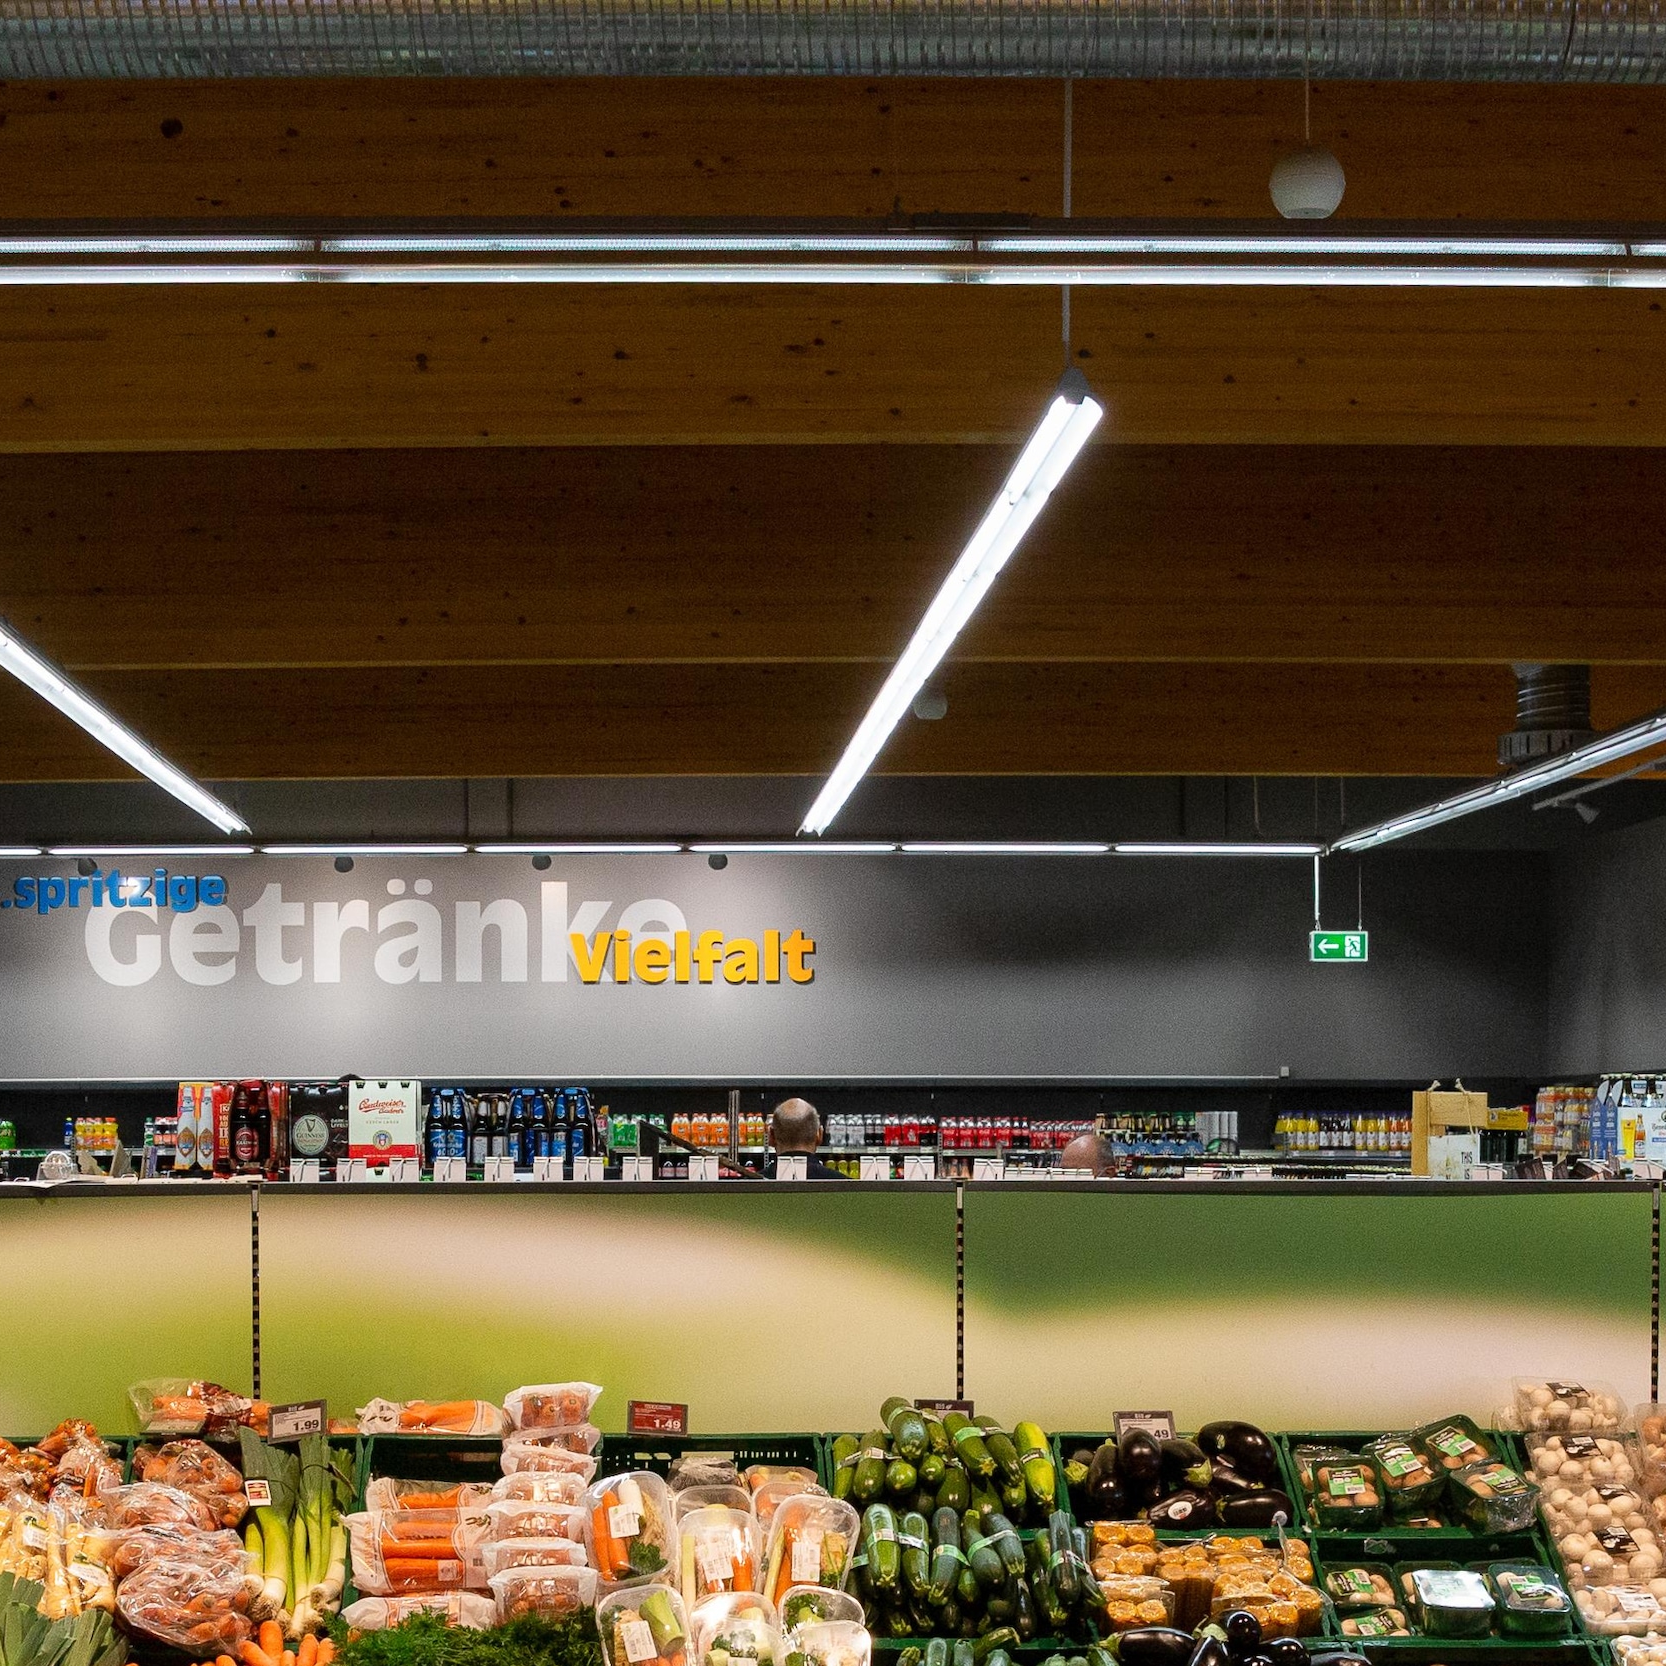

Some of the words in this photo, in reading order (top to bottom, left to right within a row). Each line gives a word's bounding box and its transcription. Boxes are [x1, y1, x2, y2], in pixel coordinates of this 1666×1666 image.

[84, 879, 689, 987] Getränke
[570, 928, 815, 985] Vielfalt
[295, 1131, 325, 1140] GUINNESS
[1460, 1151, 1473, 1164] THIS
[292, 1420, 320, 1433] 1.99
[653, 1418, 682, 1430] 1.49
[1153, 1429, 1170, 1440] 49
